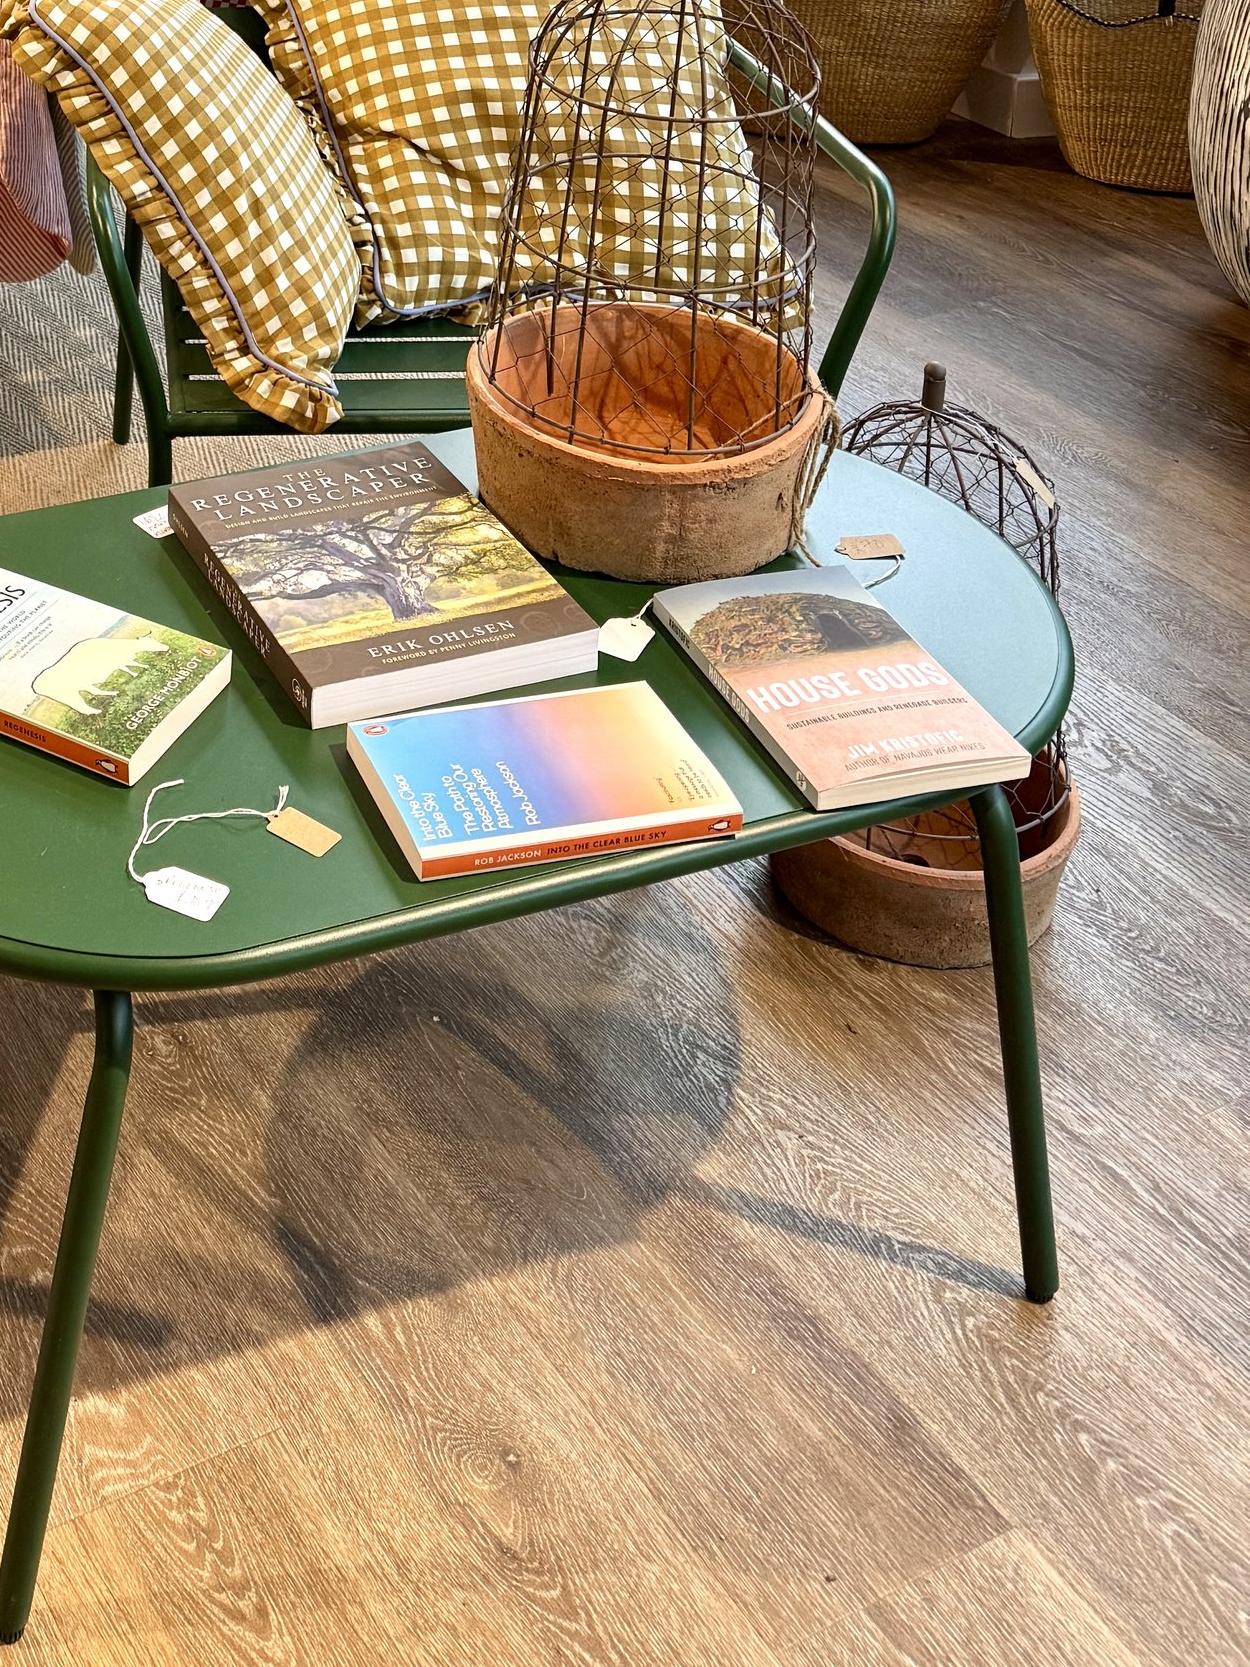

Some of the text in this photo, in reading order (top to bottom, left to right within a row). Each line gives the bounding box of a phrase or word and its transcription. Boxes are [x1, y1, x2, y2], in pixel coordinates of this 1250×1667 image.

[191, 457, 432, 512] REGENERATIVE
[214, 472, 431, 521] LANDSCAPER
[282, 468, 326, 482] THE
[225, 520, 250, 529] DESIGN
[269, 513, 288, 522] BUILD
[290, 507, 332, 518] LANDSCAPES
[333, 503, 350, 511] THAT
[352, 498, 374, 507] REPAIR
[389, 486, 437, 500] ENVIRONMENT
[7, 610, 26, 628] WORLD
[20, 614, 32, 626] THE
[29, 600, 48, 616] PLANET
[204, 553, 271, 653] REGENERATIVE
[207, 568, 267, 658] LANDSCAPER
[367, 620, 515, 658] ERIK OHLSEN
[382, 651, 427, 664] FOREWORD
[440, 643, 467, 653] PENNY
[468, 632, 516, 647] LIVINGSTON
[125, 656, 203, 731] GEORGE MONBIOT
[708, 664, 750, 723] HOUSE GODS
[746, 661, 951, 714] HOUSE GODS
[3, 720, 47, 743] REGENESIS
[786, 696, 968, 730] SUSTAINABLE BUILDINGS AND RENEGADE BUILDERS
[844, 742, 986, 772] AUTHOR OF NAVAJOS WEAR NIKES
[848, 729, 964, 760] JIM KRISTOFIC
[393, 773, 437, 841] Into the Clear
[422, 792, 453, 839] Blue Sky
[441, 775, 480, 836] The Path to
[450, 763, 497, 832] Restoring Our
[471, 768, 514, 829] Atmosphere
[495, 761, 541, 826] Rob Jackson
[474, 830, 667, 866] ROB JACKSON INTO THE CLEAR BLUE SKY
